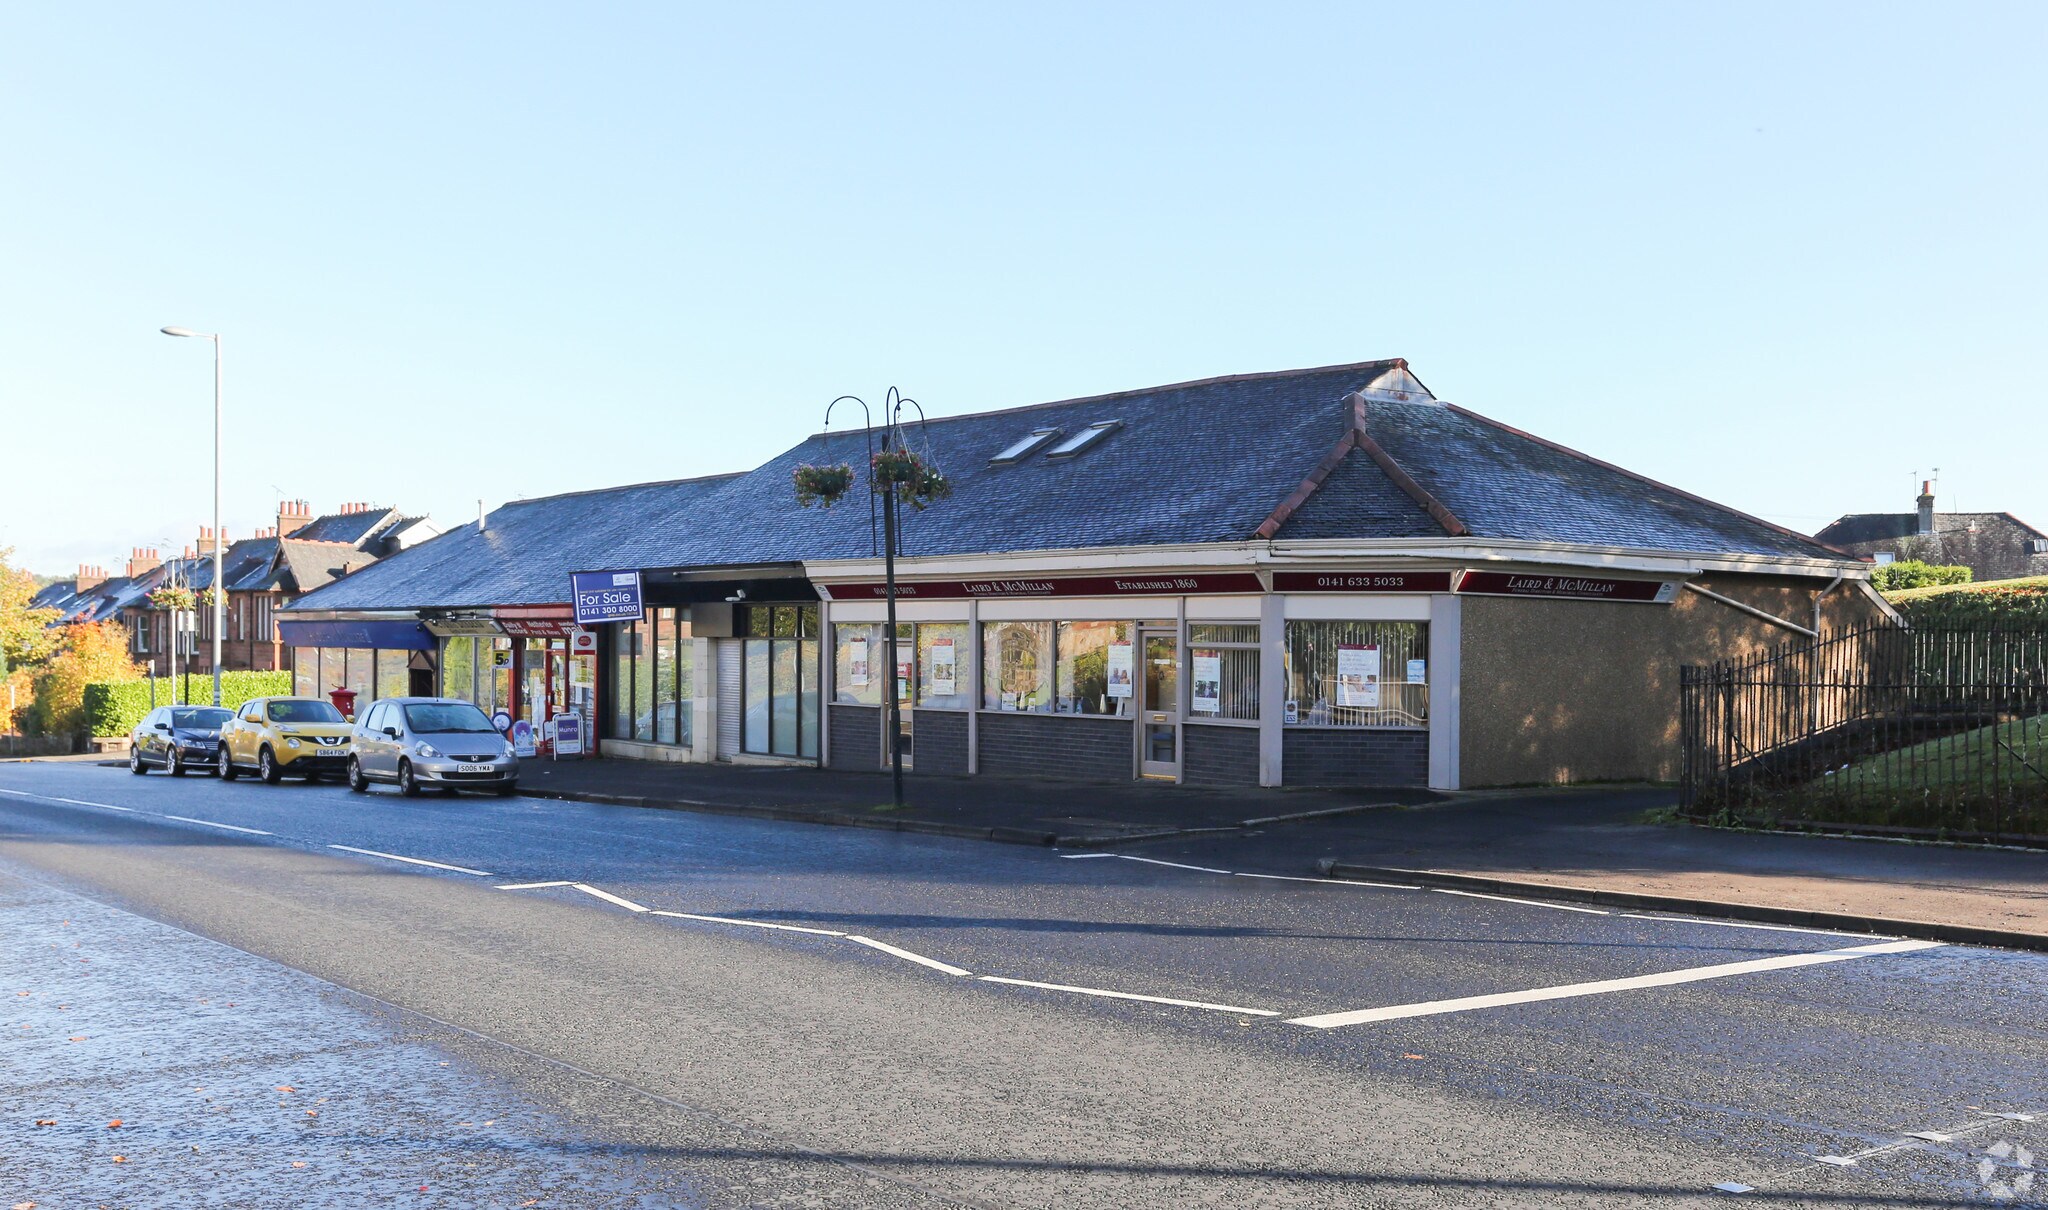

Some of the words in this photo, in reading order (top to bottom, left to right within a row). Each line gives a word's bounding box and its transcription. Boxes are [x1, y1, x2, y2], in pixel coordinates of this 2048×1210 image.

[962, 582, 992, 593] LAIRD
[992, 581, 1002, 592] &
[1114, 580, 1173, 590] ESTABLISHED
[1173, 578, 1198, 589] 1860
[1317, 577, 1344, 586] 0141
[1347, 577, 1370, 586] 633
[1373, 577, 1404, 586] 5033
[1506, 576, 1542, 589] LAIRD
[1543, 577, 1554, 590] &
[579, 594, 600, 606] For
[602, 591, 632, 604] Sale
[580, 607, 600, 616] 0141
[602, 606, 617, 614] 300
[618, 604, 638, 613] 8000
